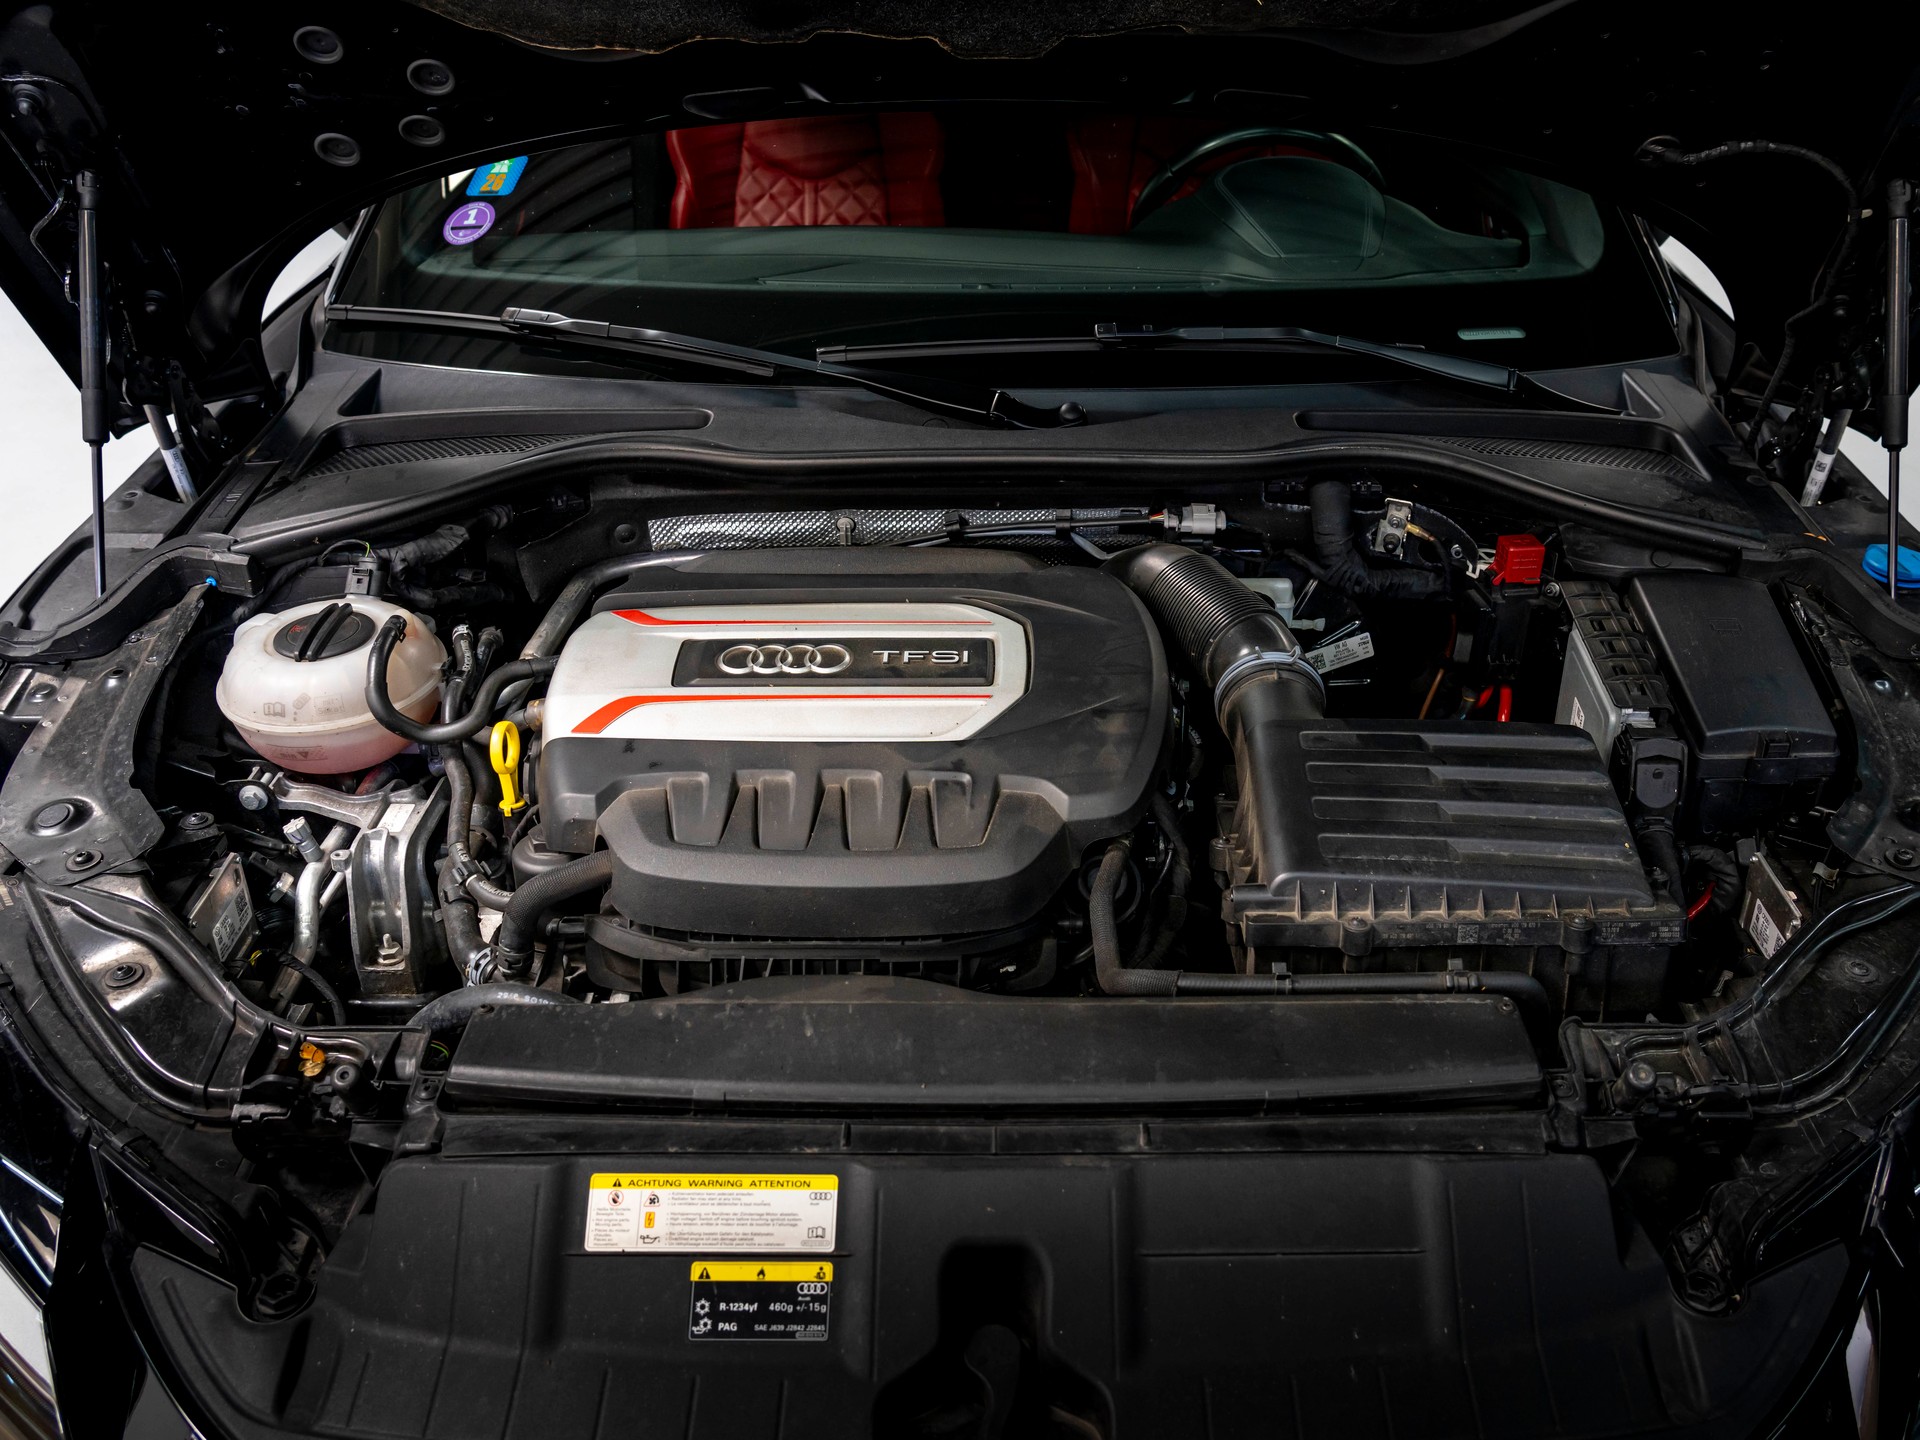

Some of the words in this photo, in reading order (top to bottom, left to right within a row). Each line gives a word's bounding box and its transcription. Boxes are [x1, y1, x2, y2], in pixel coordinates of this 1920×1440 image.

[480, 173, 507, 191] 26
[463, 208, 478, 225] 1
[872, 650, 969, 665] TFSI
[628, 1179, 682, 1188] ACHTUNG
[688, 1179, 743, 1188] WARNING
[750, 1179, 811, 1188] ATTENTION
[719, 1302, 758, 1313] R-1234yf
[769, 1302, 793, 1313] 460g
[717, 1322, 738, 1331] PAG
